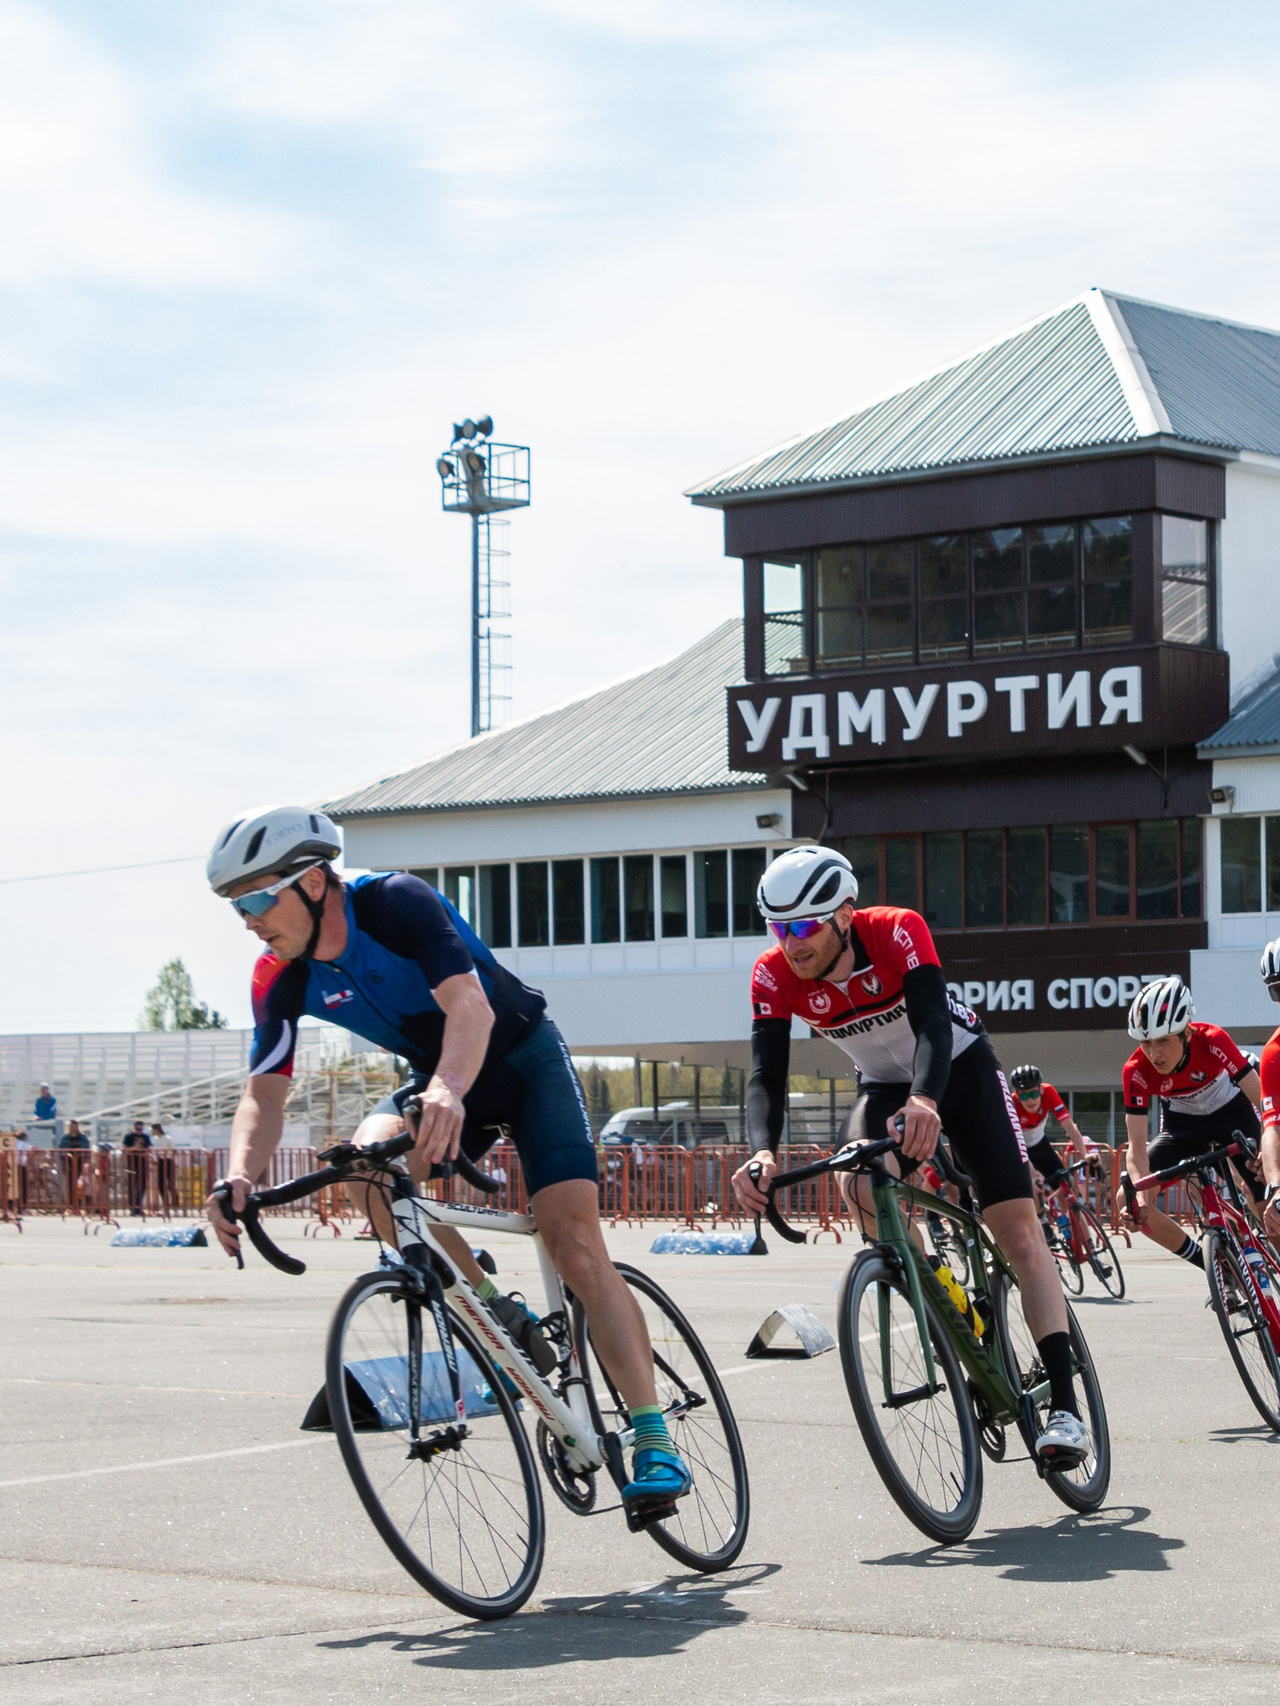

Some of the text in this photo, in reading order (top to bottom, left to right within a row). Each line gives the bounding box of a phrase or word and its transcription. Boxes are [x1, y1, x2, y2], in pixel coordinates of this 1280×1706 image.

[736, 666, 1142, 760] УДМУРТИЯ
[432, 1300, 458, 1373] MERIDA
[454, 1295, 506, 1350] MERIDA
[506, 1366, 555, 1421] MERIDA
